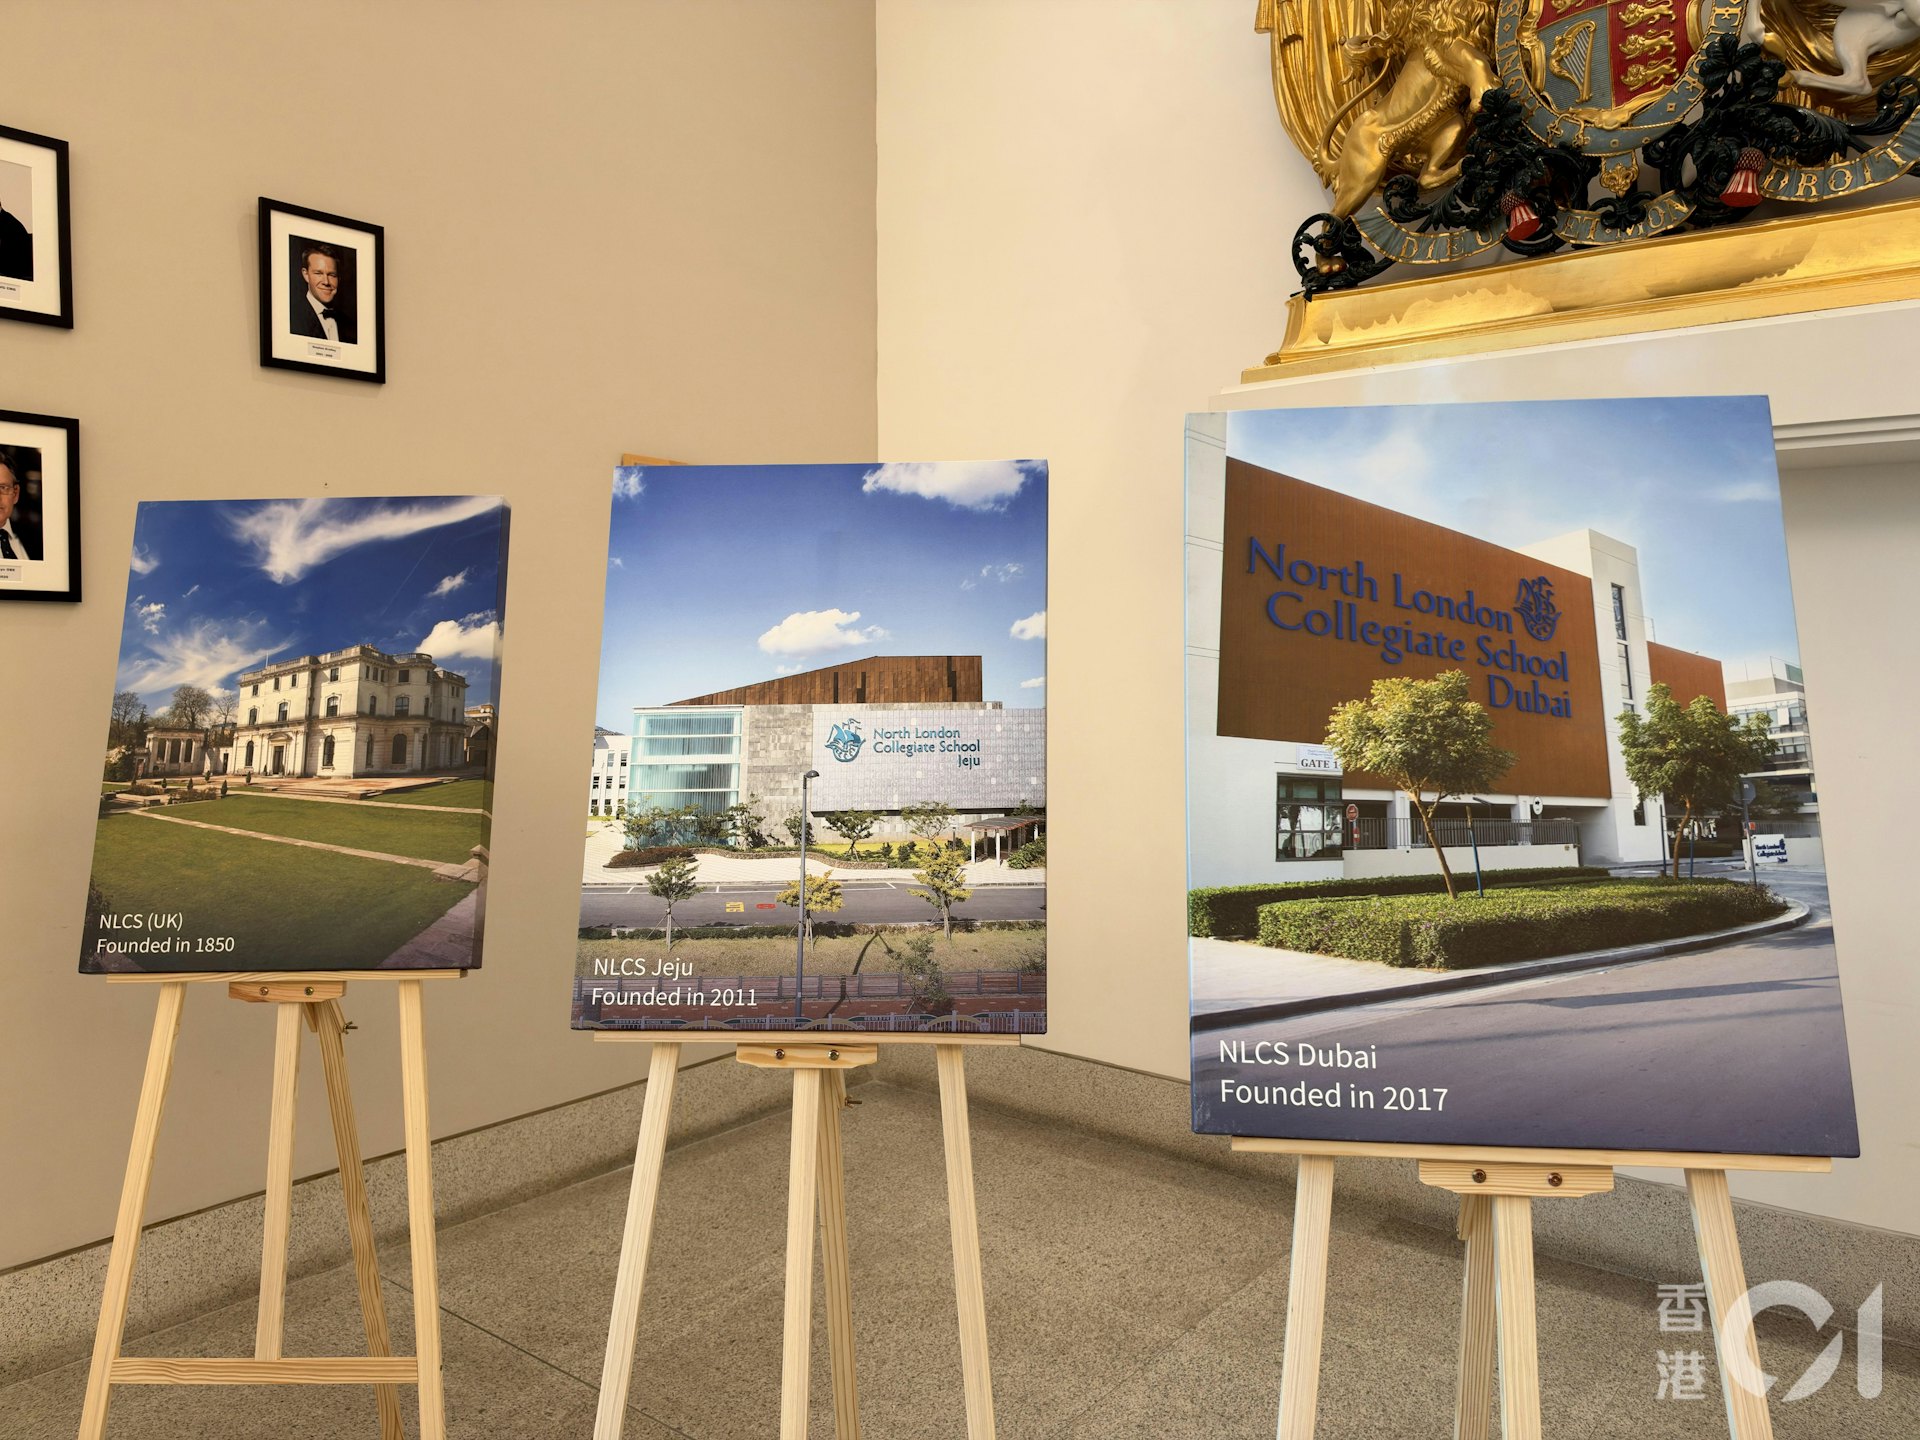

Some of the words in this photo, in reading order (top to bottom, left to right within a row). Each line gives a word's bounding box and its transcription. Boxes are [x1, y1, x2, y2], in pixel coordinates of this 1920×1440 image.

[1400, 226, 1493, 259] DIEU
[1560, 214, 1601, 240] ET
[1760, 142, 1907, 197] DROIT
[1247, 536, 1378, 602] North
[1392, 572, 1513, 634] London
[1266, 591, 1467, 665] Collegiate
[1476, 634, 1569, 682] School
[1487, 674, 1572, 718] Dubai
[873, 727, 910, 739] North
[915, 726, 960, 739] London
[873, 740, 935, 757] Collegiate
[939, 739, 980, 752] School
[958, 754, 980, 770] Jeju
[1300, 758, 1330, 769] GATE
[99, 914, 143, 929] NLCS
[147, 912, 183, 931] (UK)
[96, 937, 171, 954] Founded
[175, 937, 190, 953] in
[195, 937, 235, 953] 1850
[594, 958, 646, 976] NLCS
[651, 958, 694, 981] Jeju
[591, 987, 681, 1006] Founded
[686, 987, 704, 1006] in
[709, 988, 757, 1007] 2011
[1219, 1040, 1290, 1066] NLCS
[1298, 1043, 1377, 1069] Dubai
[1220, 1079, 1341, 1108] Founded
[1350, 1083, 1375, 1109] in
[1382, 1086, 1449, 1112] 2017
